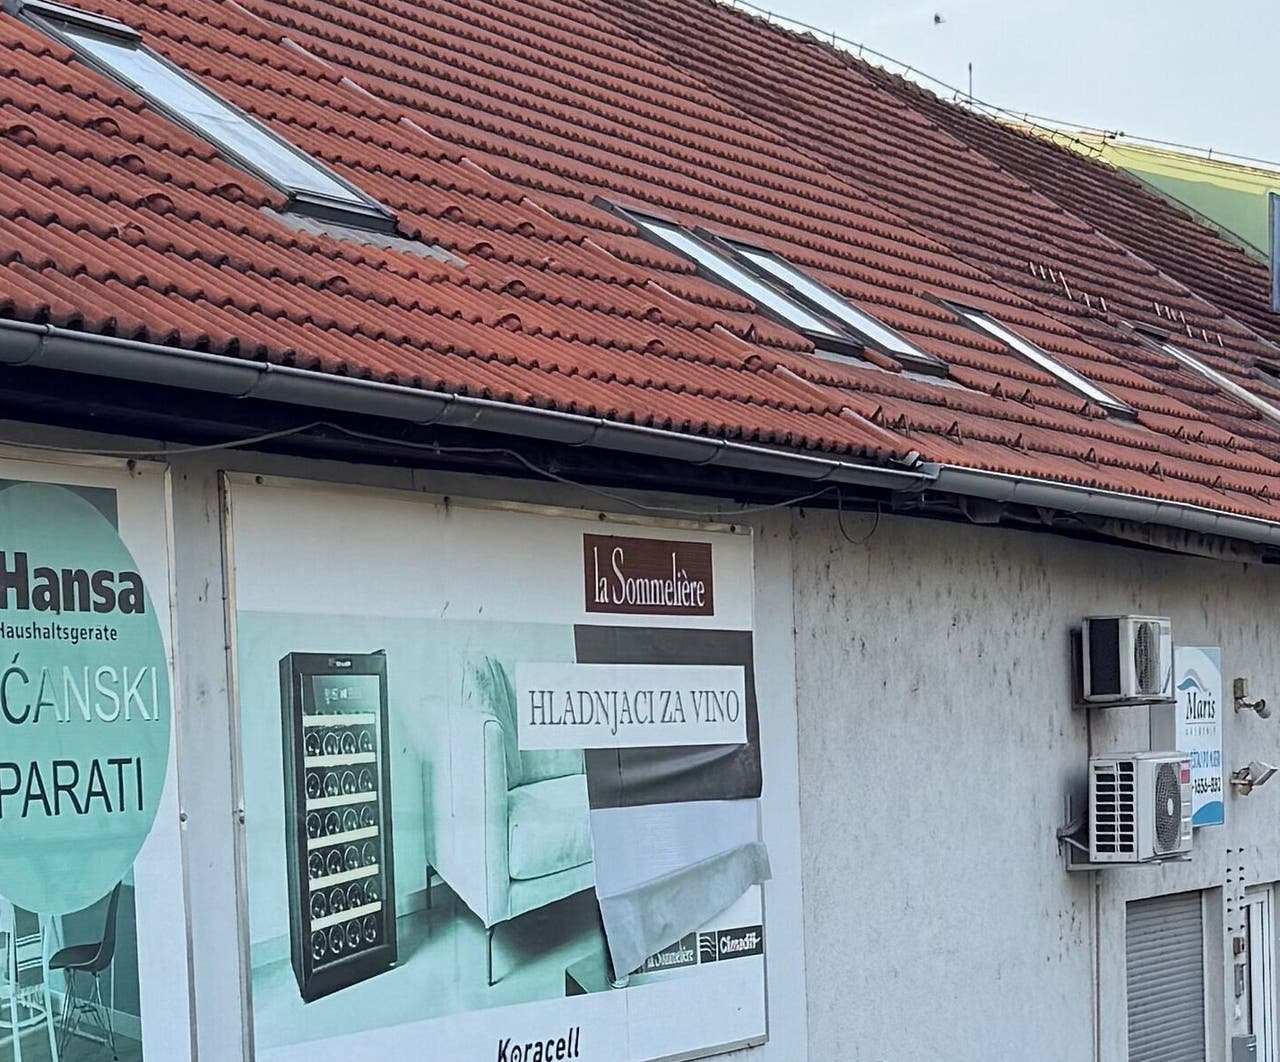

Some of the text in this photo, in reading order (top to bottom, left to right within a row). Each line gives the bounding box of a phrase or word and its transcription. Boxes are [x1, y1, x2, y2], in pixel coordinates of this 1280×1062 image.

[594, 546, 705, 607] la Sommelière
[528, 690, 740, 735] HLADNJACI ZA VINO
[1185, 692, 1216, 720] Maris
